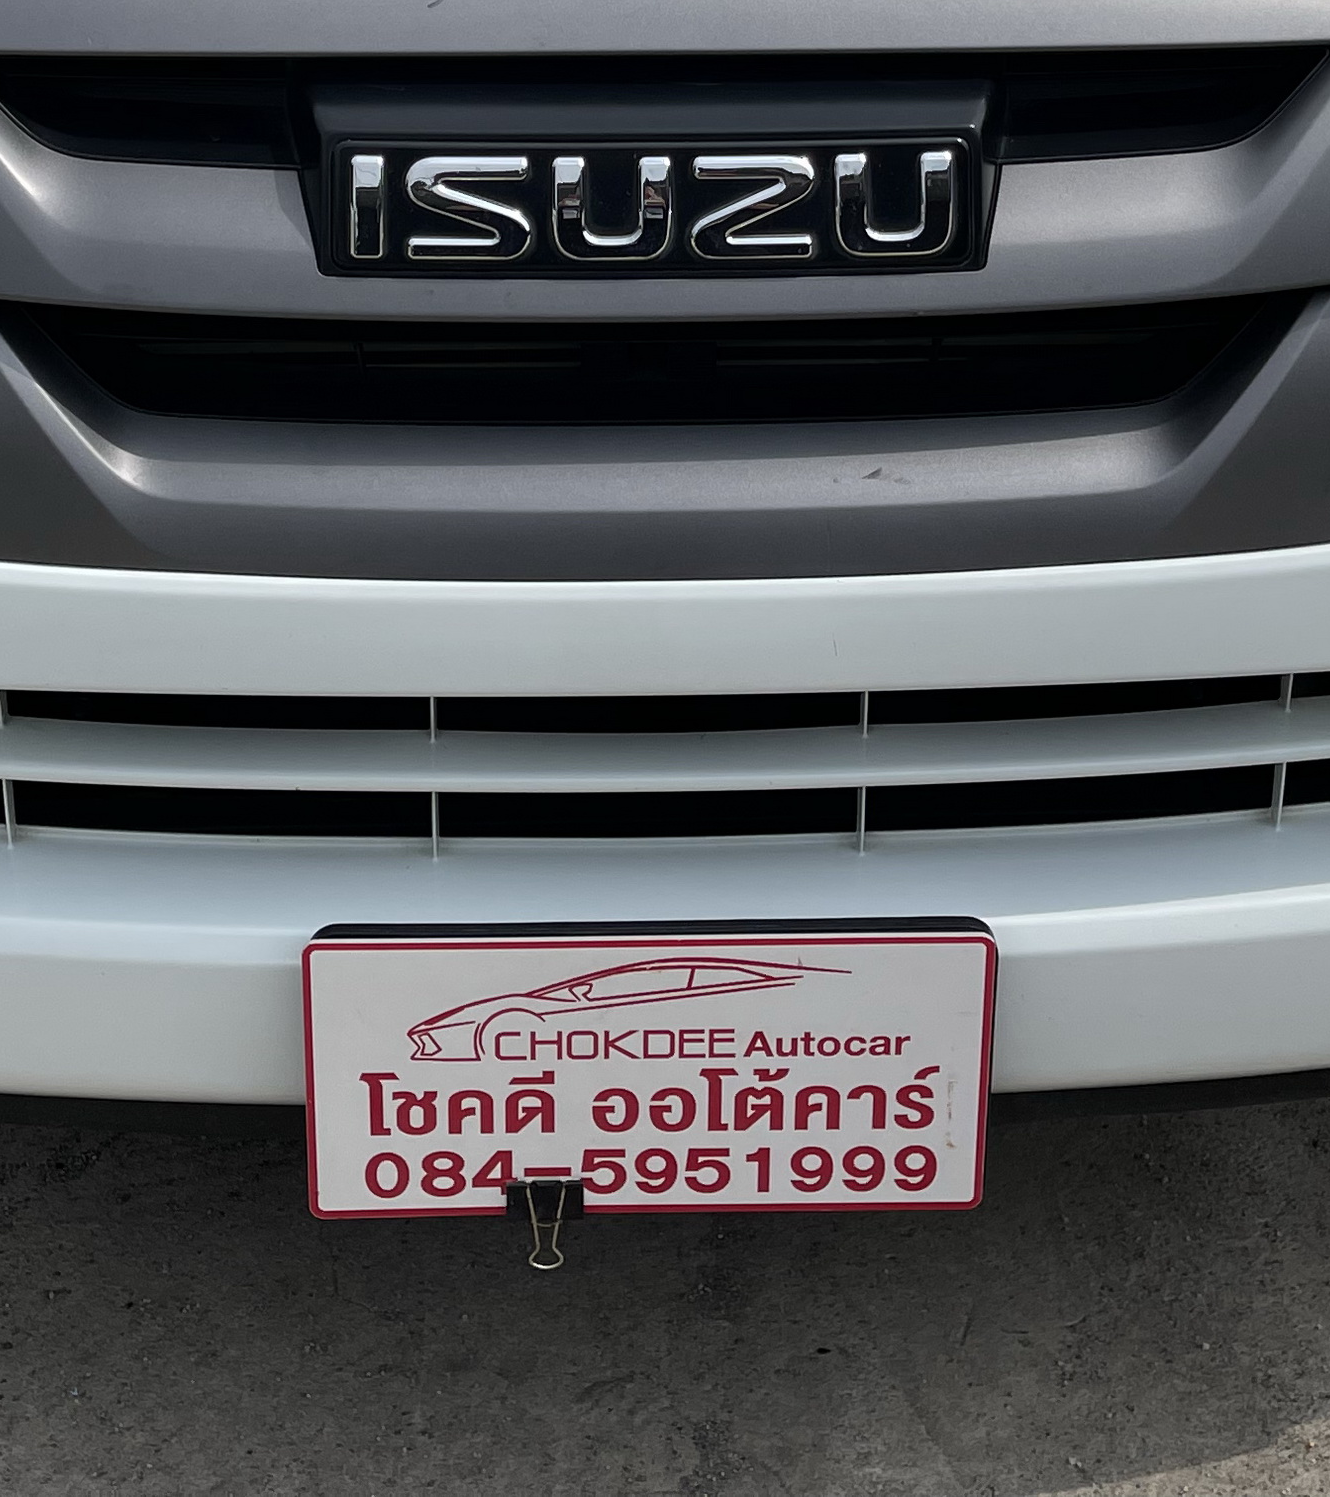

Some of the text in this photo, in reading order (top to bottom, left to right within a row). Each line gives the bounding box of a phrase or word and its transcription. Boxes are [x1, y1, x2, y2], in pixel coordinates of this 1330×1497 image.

[349, 151, 954, 261] ISUZU
[494, 1028, 911, 1061] CHOKDEE Autocar
[359, 1065, 941, 1136] โชคดี ออโต้คาร์
[364, 1145, 939, 1199] 084-5951999
